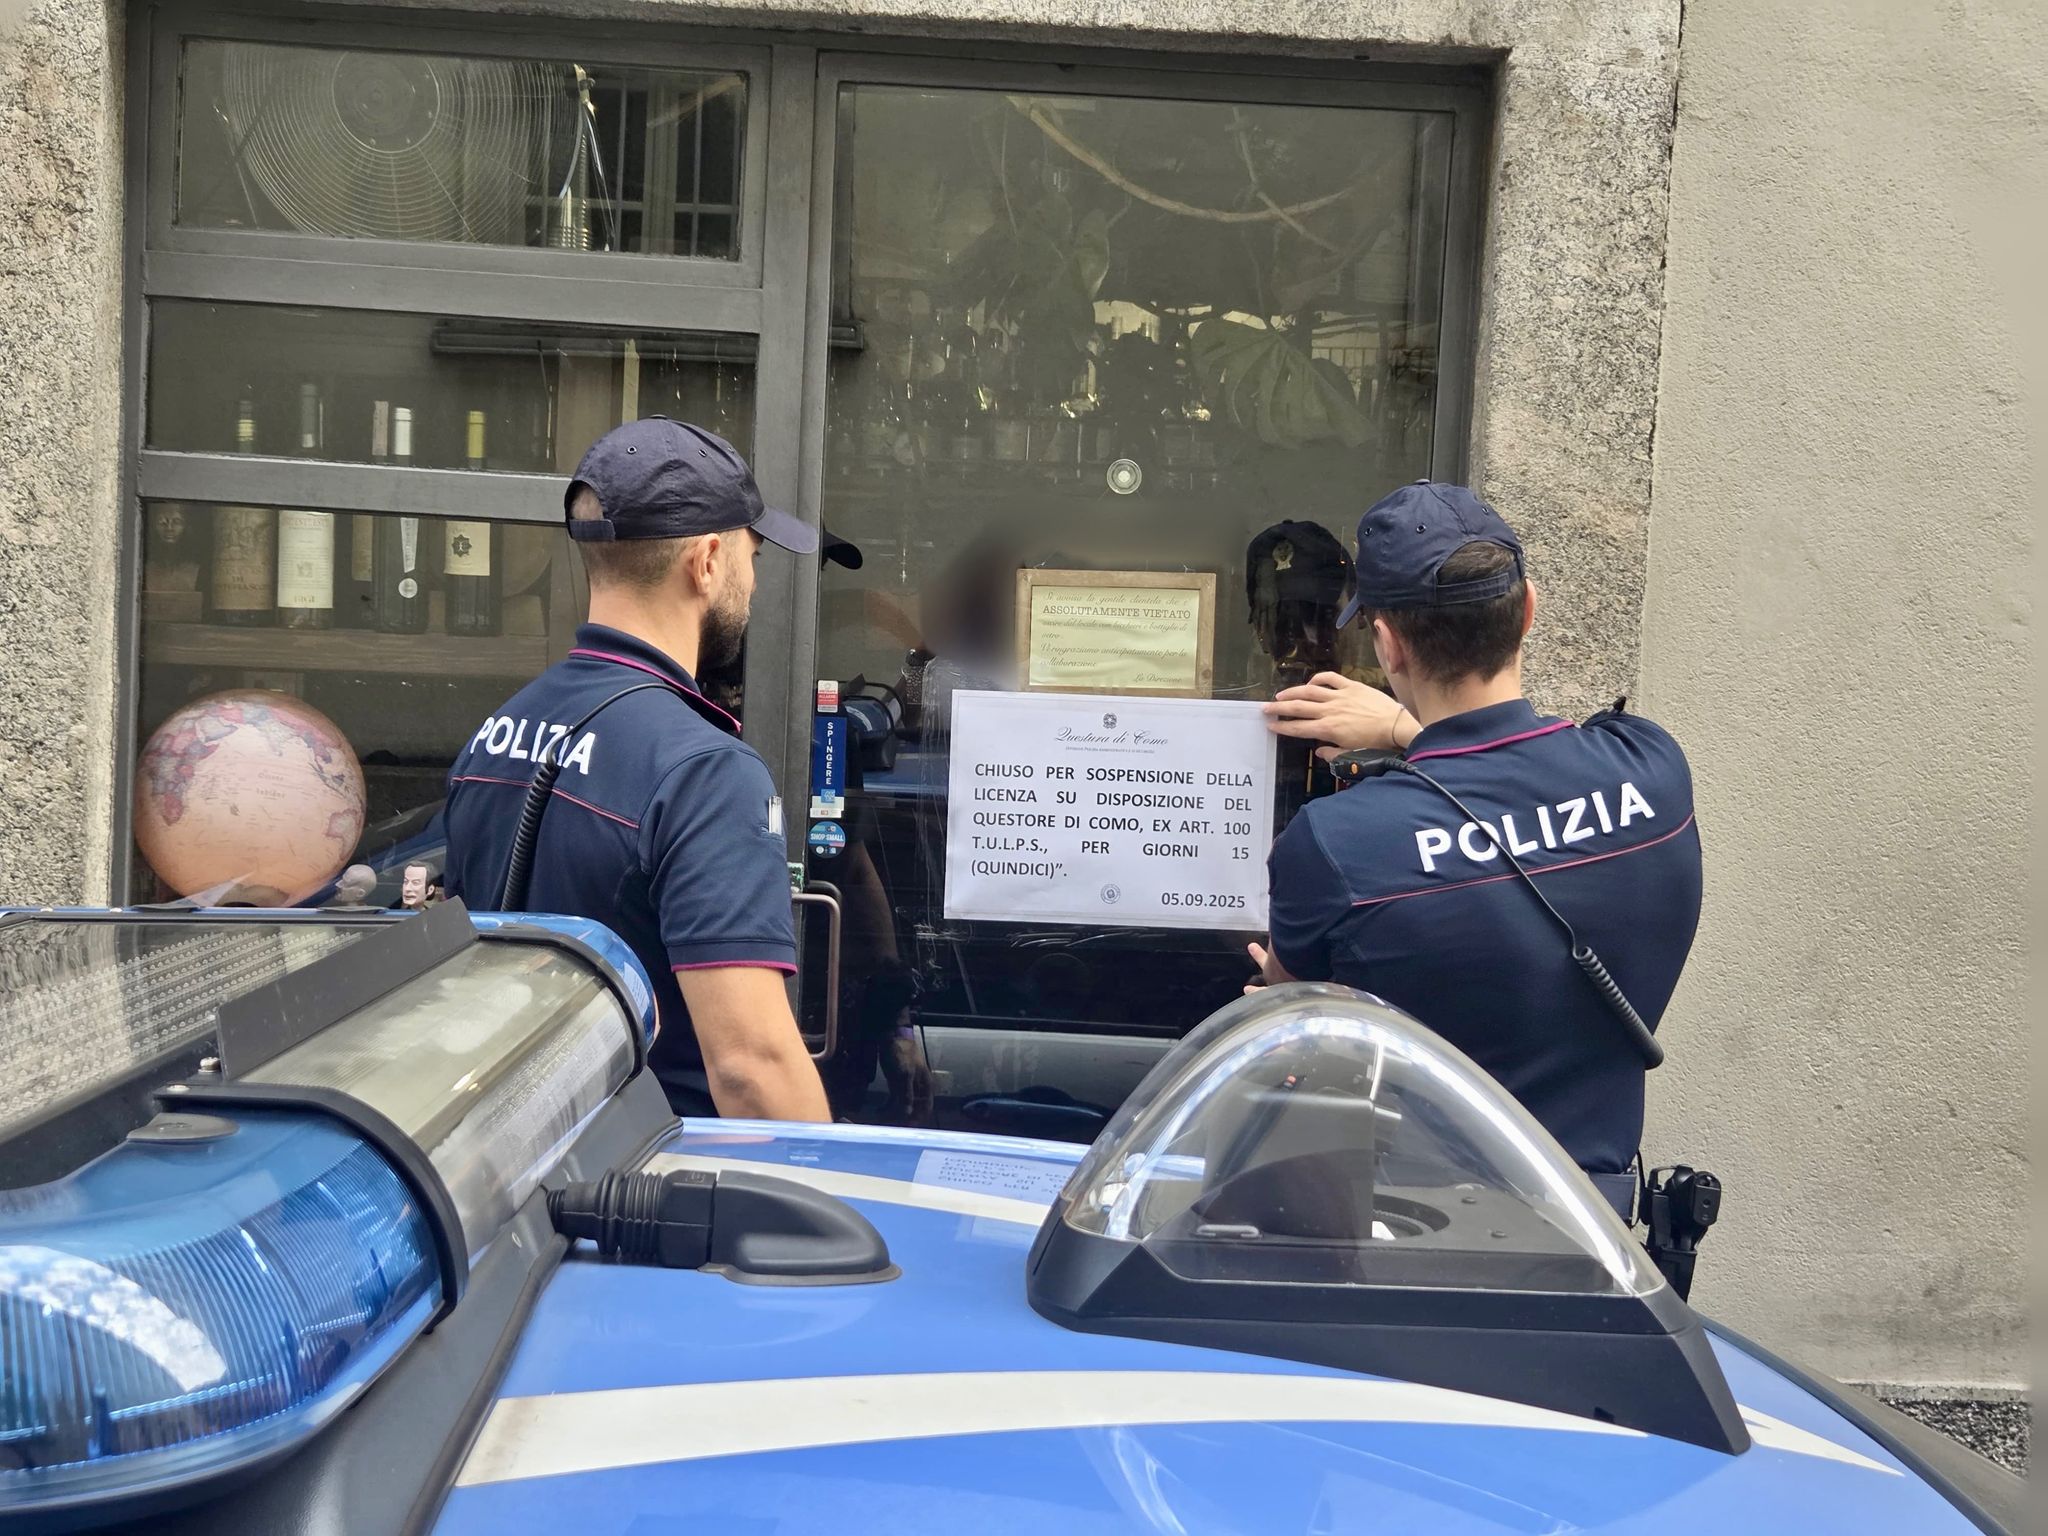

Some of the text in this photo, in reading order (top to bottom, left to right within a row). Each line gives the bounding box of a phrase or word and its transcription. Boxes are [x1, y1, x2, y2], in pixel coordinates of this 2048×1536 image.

[1042, 605, 1192, 620] ASSOLUTAMENTE VIETATO
[470, 715, 596, 775] POLIZIA
[1053, 726, 1169, 746] Questura di Como
[825, 721, 834, 785] SPINGERE
[974, 763, 1255, 788] CHIUSO PER SOSPENSIONE DELLA
[974, 787, 1253, 812] LICENZA SU DISPOSIZIONE DEL
[972, 811, 1251, 836] QUESTORE DI COMO, EX ART. 100
[1415, 782, 1655, 872] POLIZIA
[971, 835, 1250, 860] T.U.L.P.S., PER GIORNI 15
[1161, 892, 1246, 909] 05.09.2025
